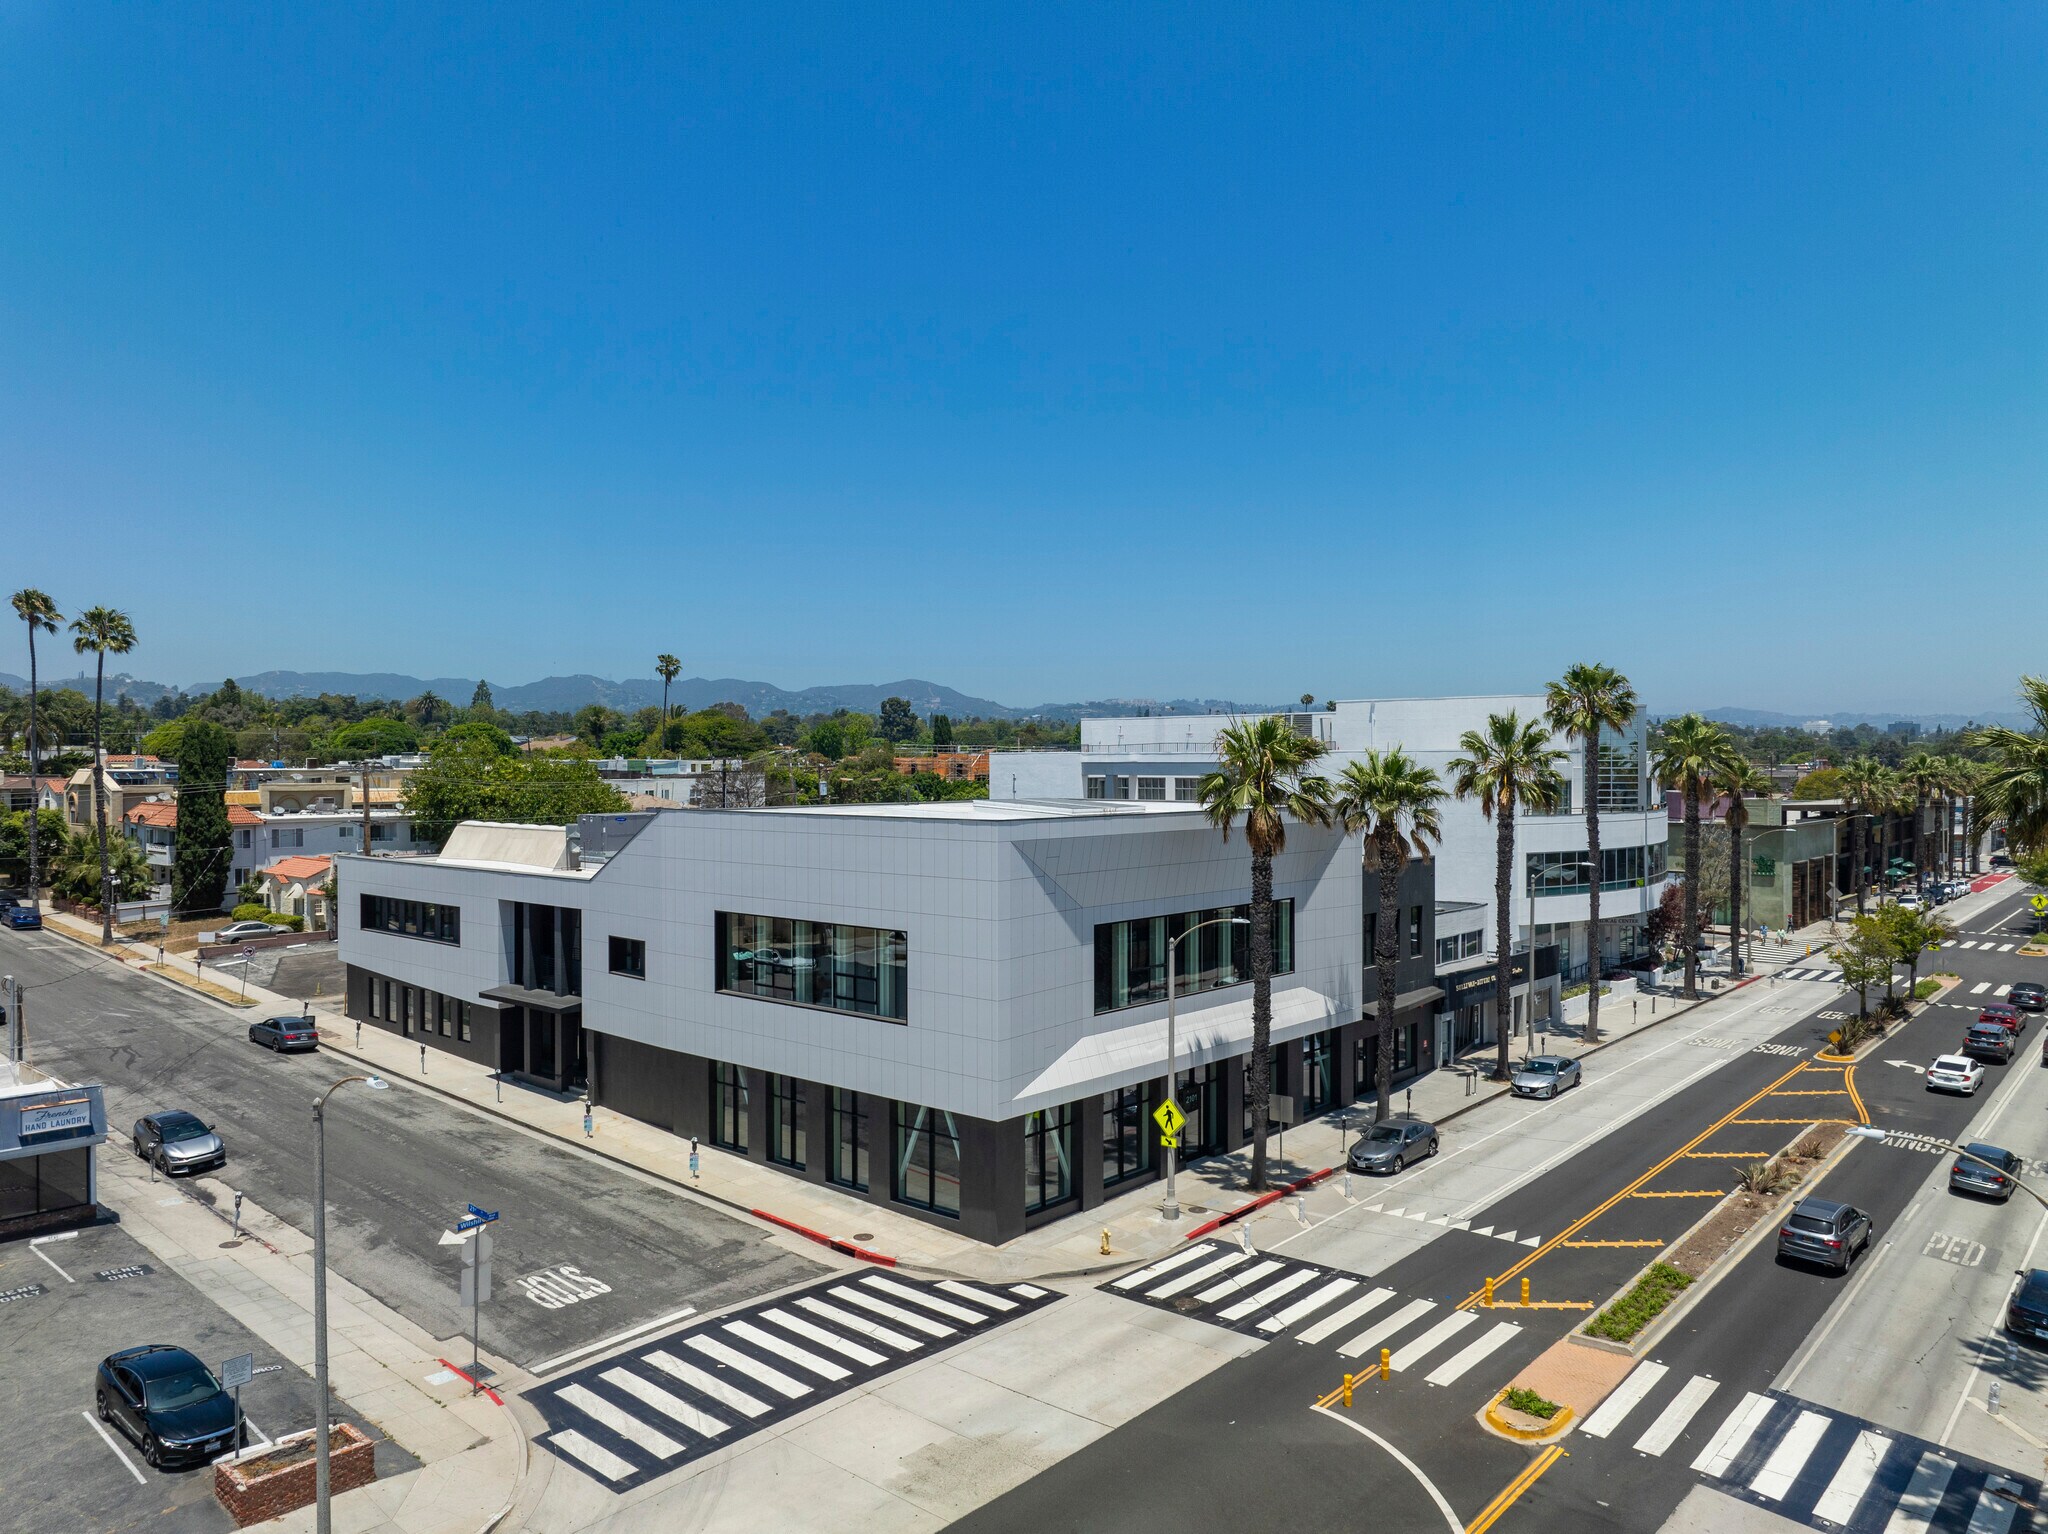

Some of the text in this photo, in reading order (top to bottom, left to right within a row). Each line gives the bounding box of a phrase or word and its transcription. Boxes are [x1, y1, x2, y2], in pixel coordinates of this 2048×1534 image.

[1753, 1043, 1808, 1058] XINGS
[35, 1107, 78, 1122] French
[25, 1115, 87, 1132] HAND LAUNDRY
[1879, 1129, 1952, 1155] XINGS
[1922, 1231, 1987, 1267] PED
[107, 1270, 145, 1281] ONLY
[516, 1266, 613, 1309] STOP
[0, 1290, 40, 1303] ONLY
